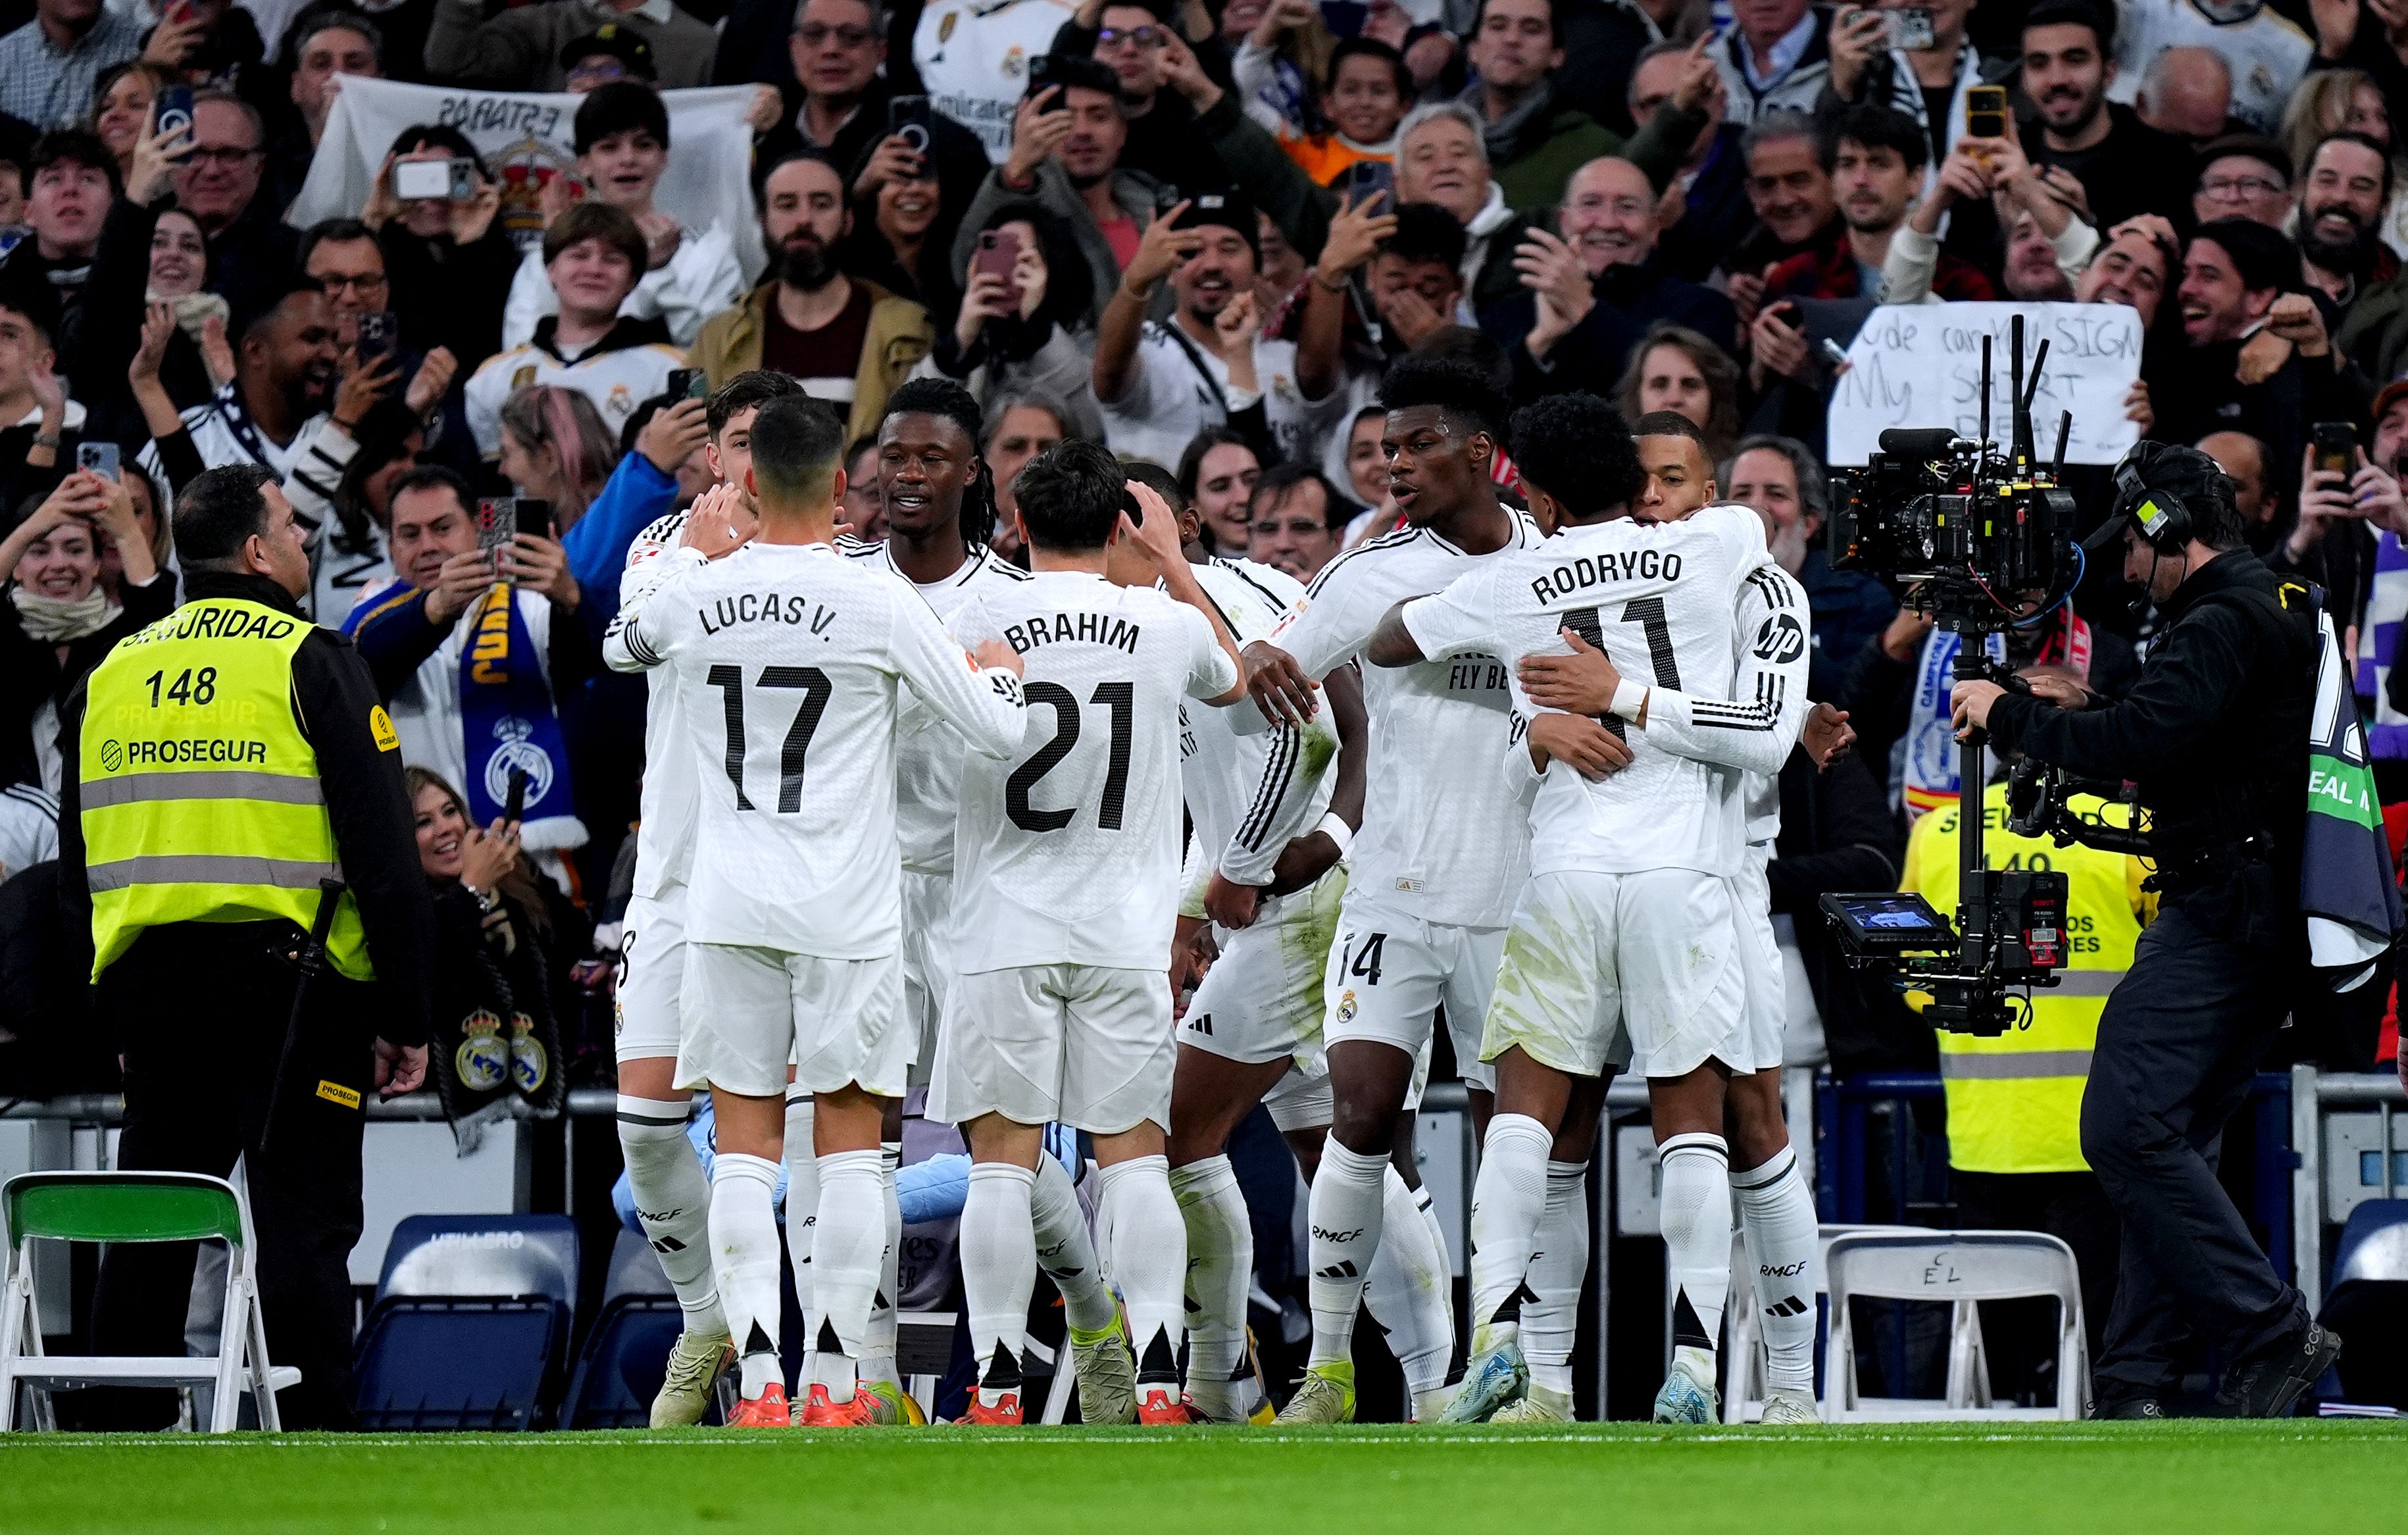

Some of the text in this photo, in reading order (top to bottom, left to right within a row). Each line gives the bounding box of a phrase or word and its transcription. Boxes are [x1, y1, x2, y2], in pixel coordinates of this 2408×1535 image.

[2057, 317, 2137, 360] SIGN
[1844, 351, 1913, 425] My
[1531, 549, 1682, 606] RODRYGO
[123, 607, 295, 647] SEGURIDAD
[699, 593, 836, 643] LUCAS V.
[1004, 613, 1140, 656] BRAHIM
[1753, 613, 1804, 664] hp
[145, 667, 218, 709] 148
[1449, 665, 1481, 690] FLY
[1557, 596, 1682, 749] 11
[128, 739, 266, 765] PROSEGUR
[706, 665, 832, 813] 17
[1005, 681, 1134, 833] 21
[2309, 770, 2353, 805] EAL
[1338, 932, 1388, 987] 14
[322, 1085, 359, 1103] PROSEGUR
[1313, 1225, 1364, 1243] RMCF
[1760, 1261, 1807, 1277] RMCF
